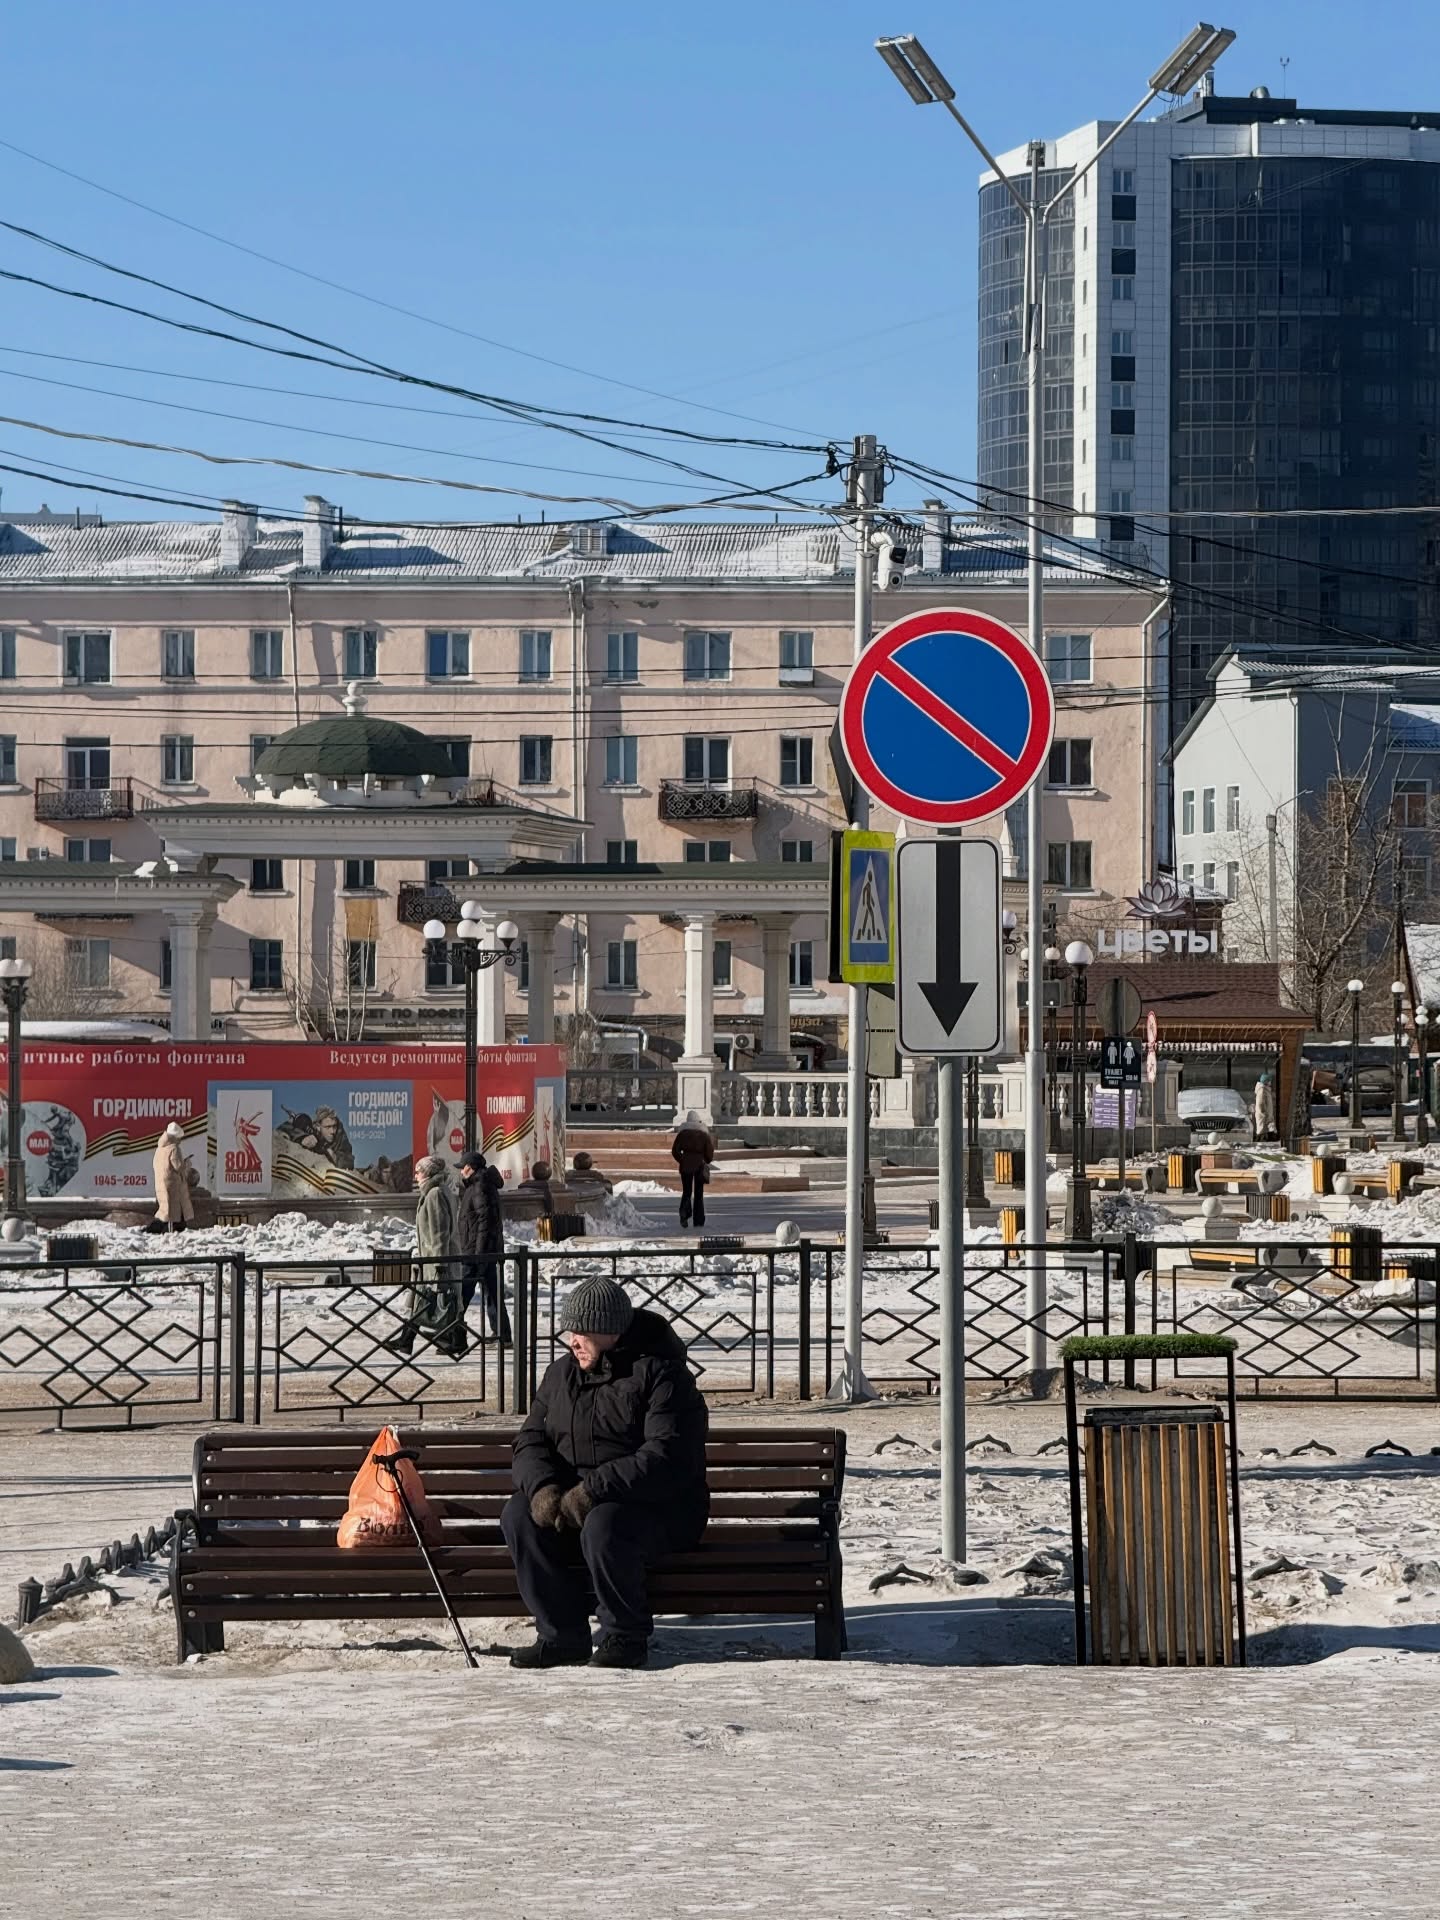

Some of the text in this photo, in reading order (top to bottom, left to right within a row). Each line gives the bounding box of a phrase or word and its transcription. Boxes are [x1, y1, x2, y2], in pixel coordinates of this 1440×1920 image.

[392, 1008, 411, 1018] ПО
[0, 1049, 245, 1067] мнтные работы фонтана
[330, 1050, 387, 1067] Ведутся
[392, 1051, 462, 1067] ремонтные
[505, 1049, 537, 1066] фонтана
[94, 1098, 192, 1119] ГОРДИМСЯ!
[348, 1091, 408, 1109] ГОРДИМСЯ
[487, 1096, 526, 1115] ПОМНИМ!
[348, 1109, 403, 1128] ПОБЕДОЙ!
[29, 1137, 50, 1149] МАЯ
[94, 1175, 148, 1186] 1945-2025
[225, 1171, 263, 1184] ПОБЕДА!
